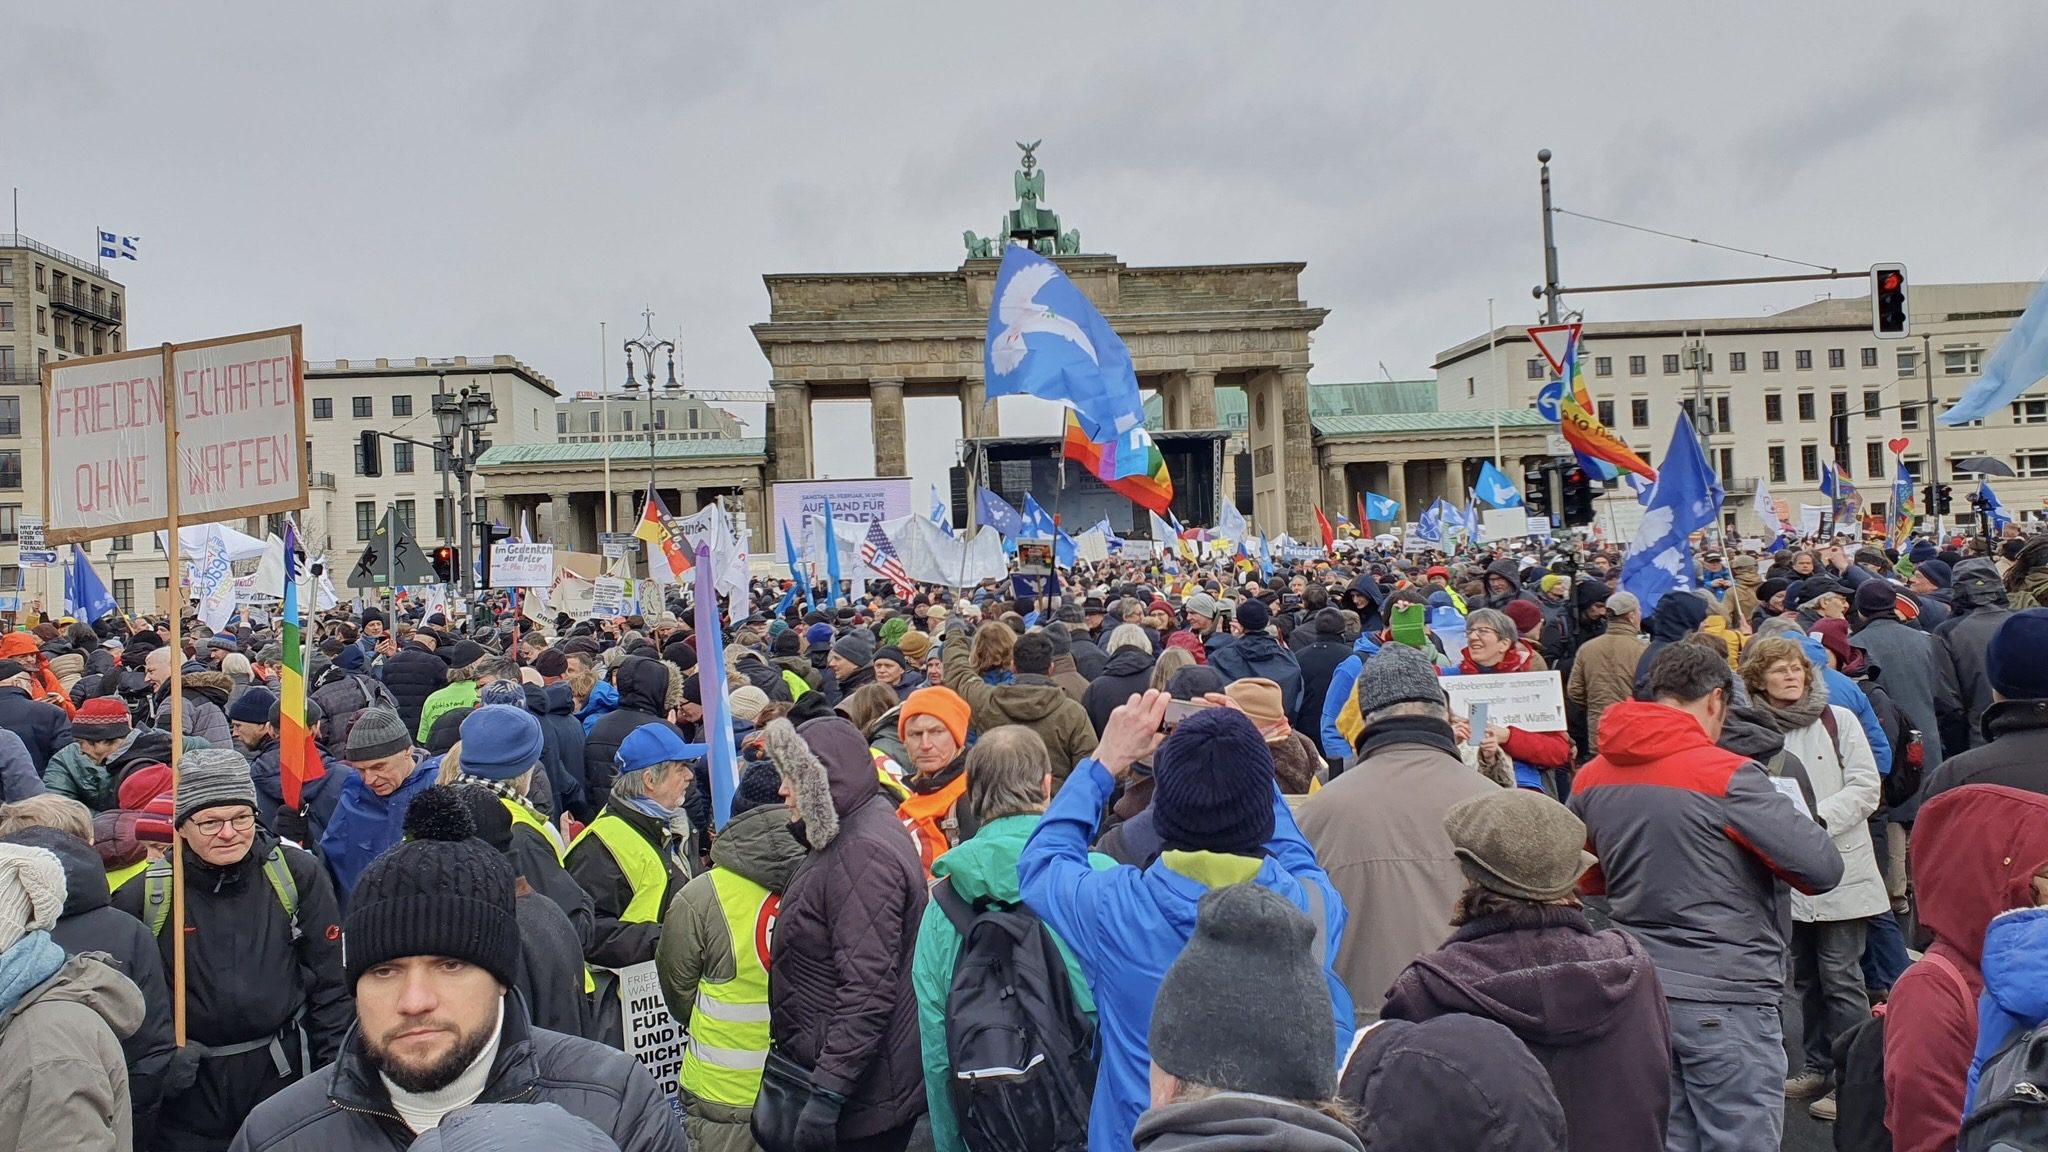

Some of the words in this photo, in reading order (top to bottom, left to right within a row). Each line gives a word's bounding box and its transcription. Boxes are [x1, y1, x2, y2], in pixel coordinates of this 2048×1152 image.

[56, 376, 164, 437] FRIEDEN
[183, 356, 299, 419] SCHAFFEN
[75, 456, 150, 512] OHNE
[187, 433, 289, 495] WAFFEN
[802, 502, 860, 512] AUFTAND
[863, 499, 885, 511] FÜR
[495, 545, 507, 555] Im
[508, 544, 553, 555] Gedenken
[627, 971, 658, 985] FRIED
[628, 981, 661, 996] WAFF
[631, 995, 664, 1014] MIL
[632, 1010, 669, 1032] FÜR
[634, 1028, 674, 1048] UND
[678, 1025, 689, 1038] K
[635, 1041, 688, 1065] NICHT
